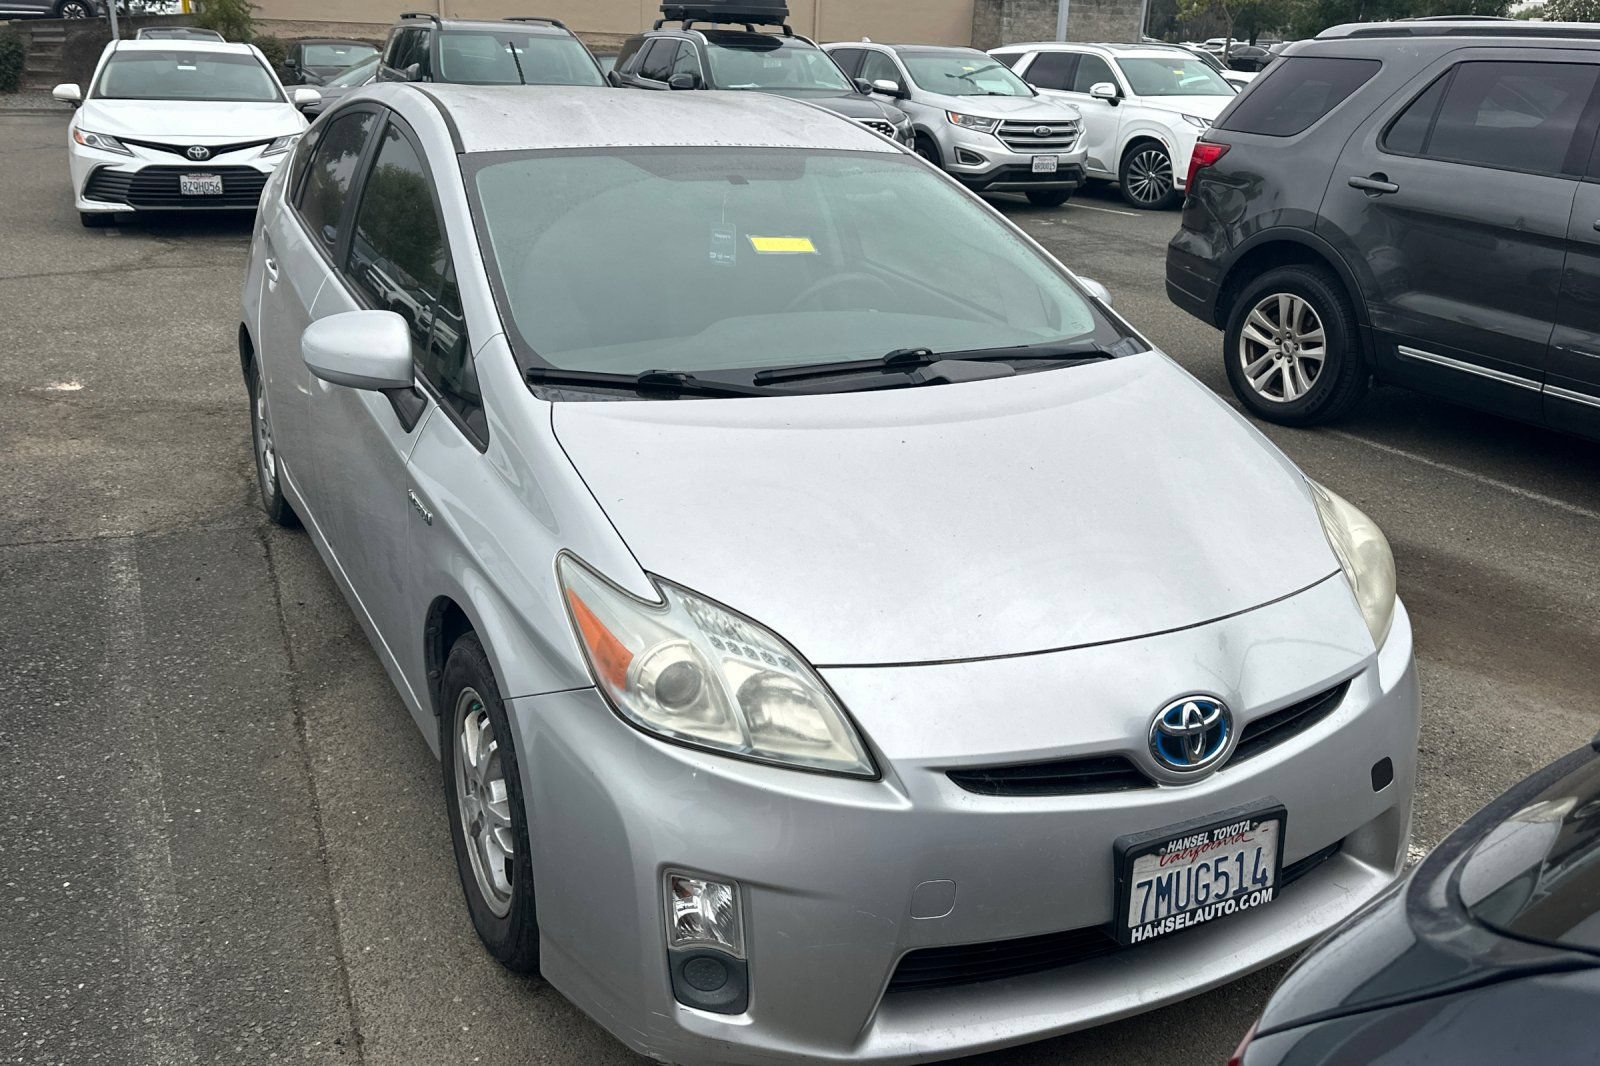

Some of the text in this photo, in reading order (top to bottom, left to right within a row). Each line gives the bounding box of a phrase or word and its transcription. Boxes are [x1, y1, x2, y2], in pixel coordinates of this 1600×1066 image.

[182, 181, 221, 193] 8ZQH056
[1159, 832, 1254, 867] California
[1167, 819, 1251, 854] HANSEL TOYOTA
[1136, 846, 1268, 923] 7MUG514
[1130, 888, 1274, 944] HANSELAUTO.COM
